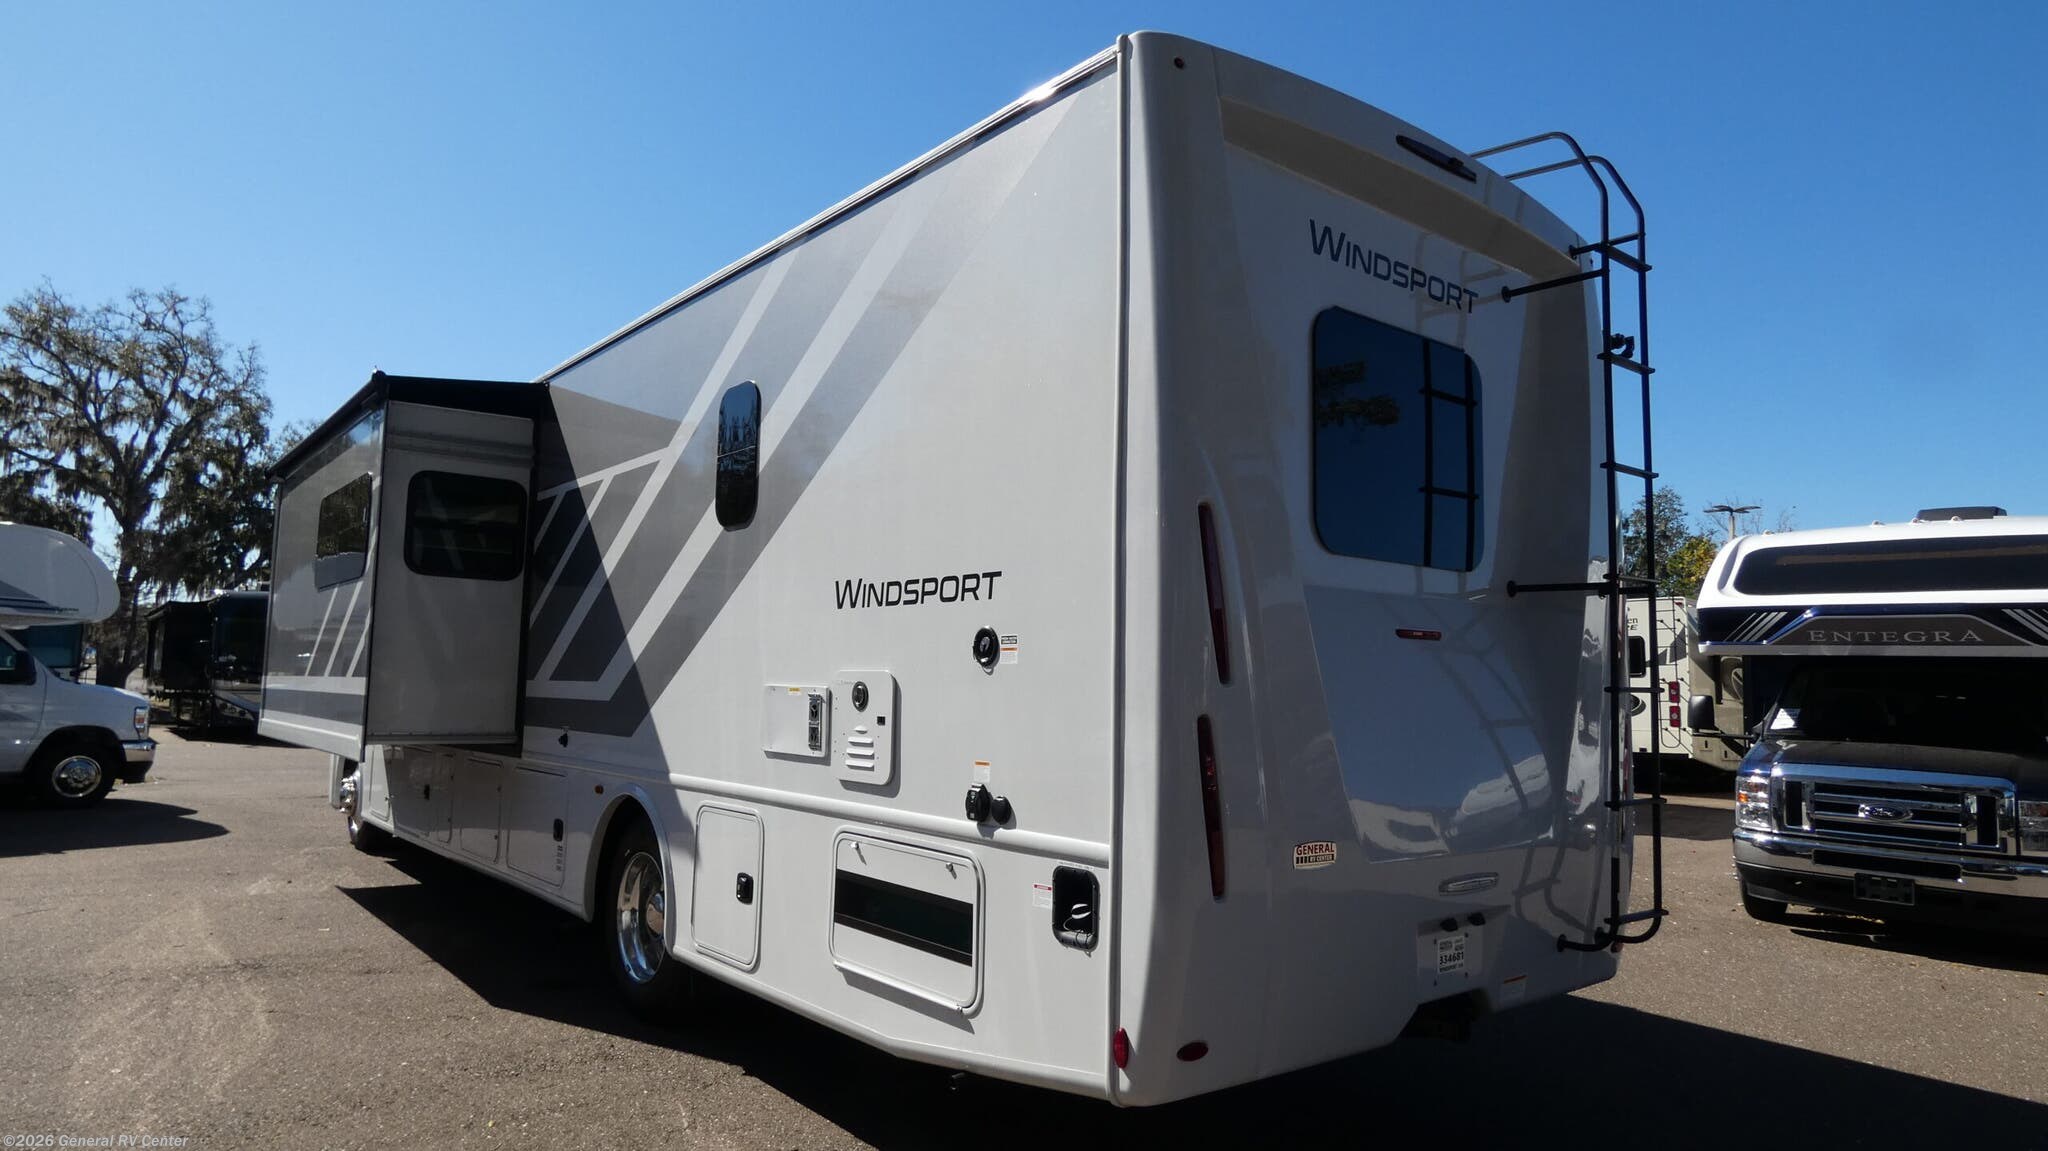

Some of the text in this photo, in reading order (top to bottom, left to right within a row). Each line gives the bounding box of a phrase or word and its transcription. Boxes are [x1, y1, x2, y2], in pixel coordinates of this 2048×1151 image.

[1309, 218, 1479, 313] WINDSPORT
[835, 571, 1002, 609] WINDSPORT
[1807, 629, 1984, 642] ENTEGRA
[1296, 843, 1334, 855] GENERAL
